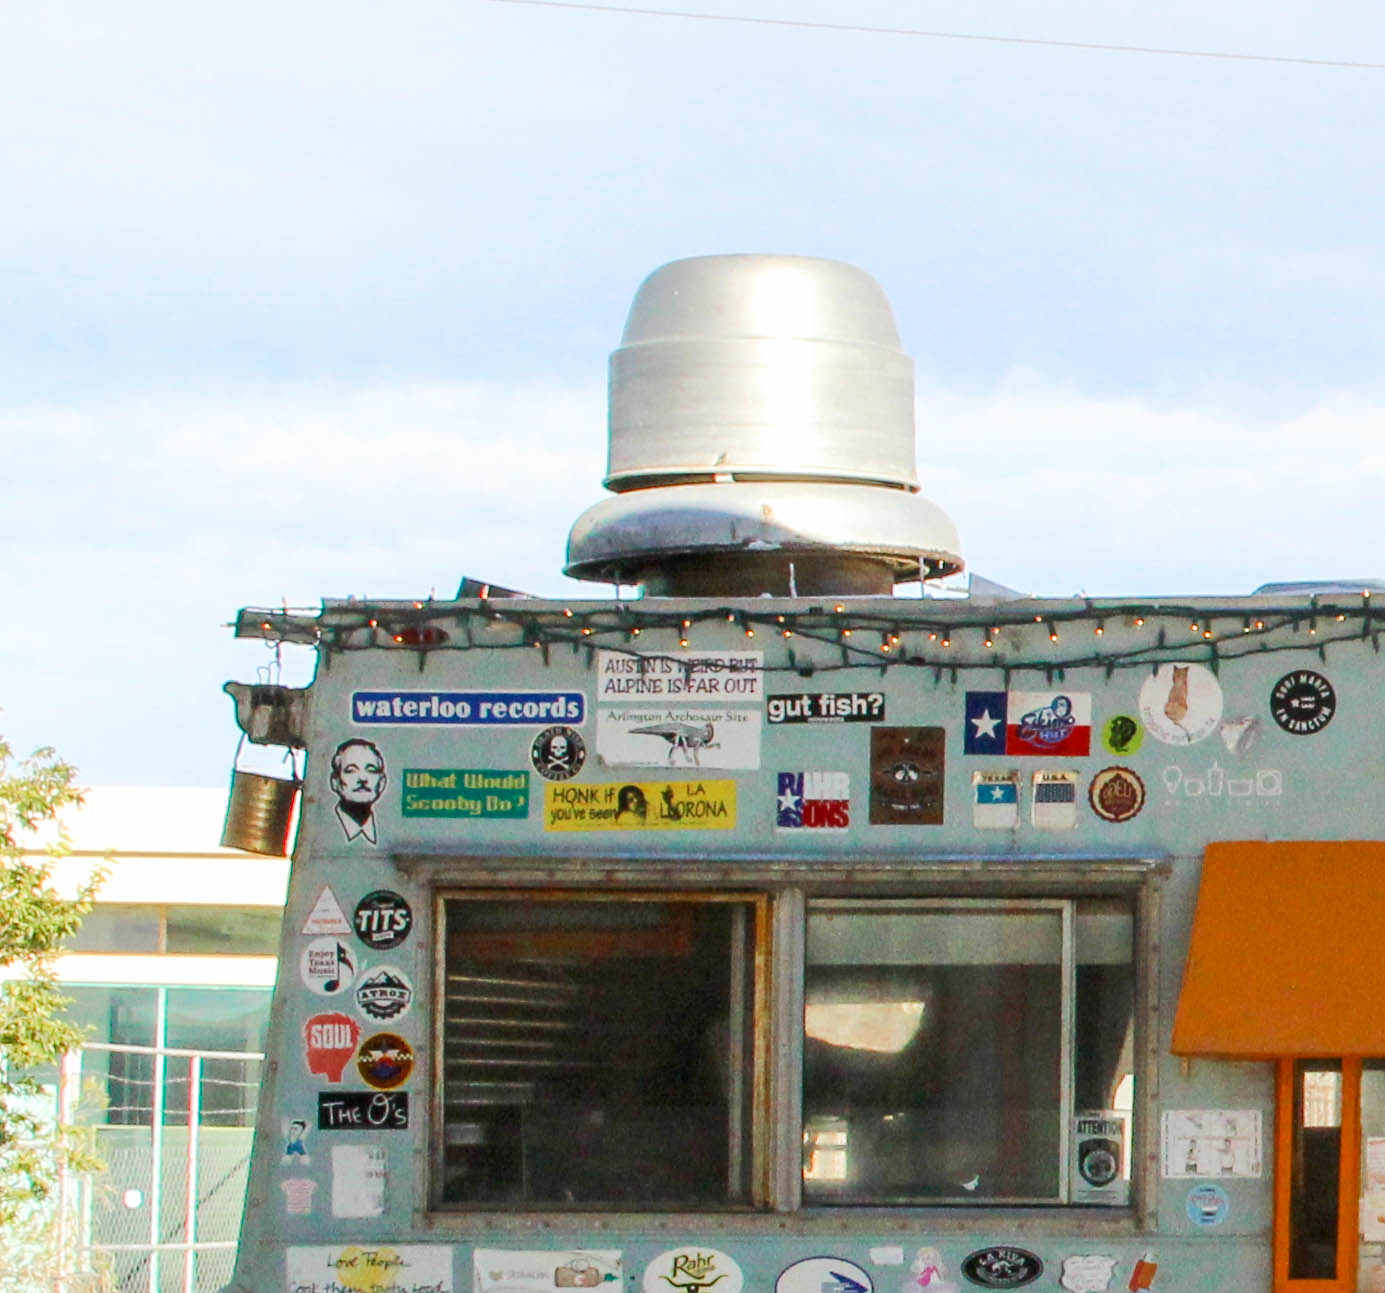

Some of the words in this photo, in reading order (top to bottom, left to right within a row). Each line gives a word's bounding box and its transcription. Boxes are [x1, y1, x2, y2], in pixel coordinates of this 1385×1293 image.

[661, 659, 672, 673] IS
[605, 678, 663, 693] ALPINE
[667, 679, 680, 693] IS
[687, 679, 719, 693] FAR
[725, 679, 757, 693] OUT
[356, 696, 471, 718] waterloo
[480, 696, 579, 718] records
[726, 712, 748, 722] Site
[768, 696, 811, 722] gut
[819, 693, 884, 716] fish?
[406, 795, 482, 815] Scooby
[553, 788, 598, 807] HONK
[359, 910, 407, 931] TITS
[311, 1025, 353, 1049] SOUL
